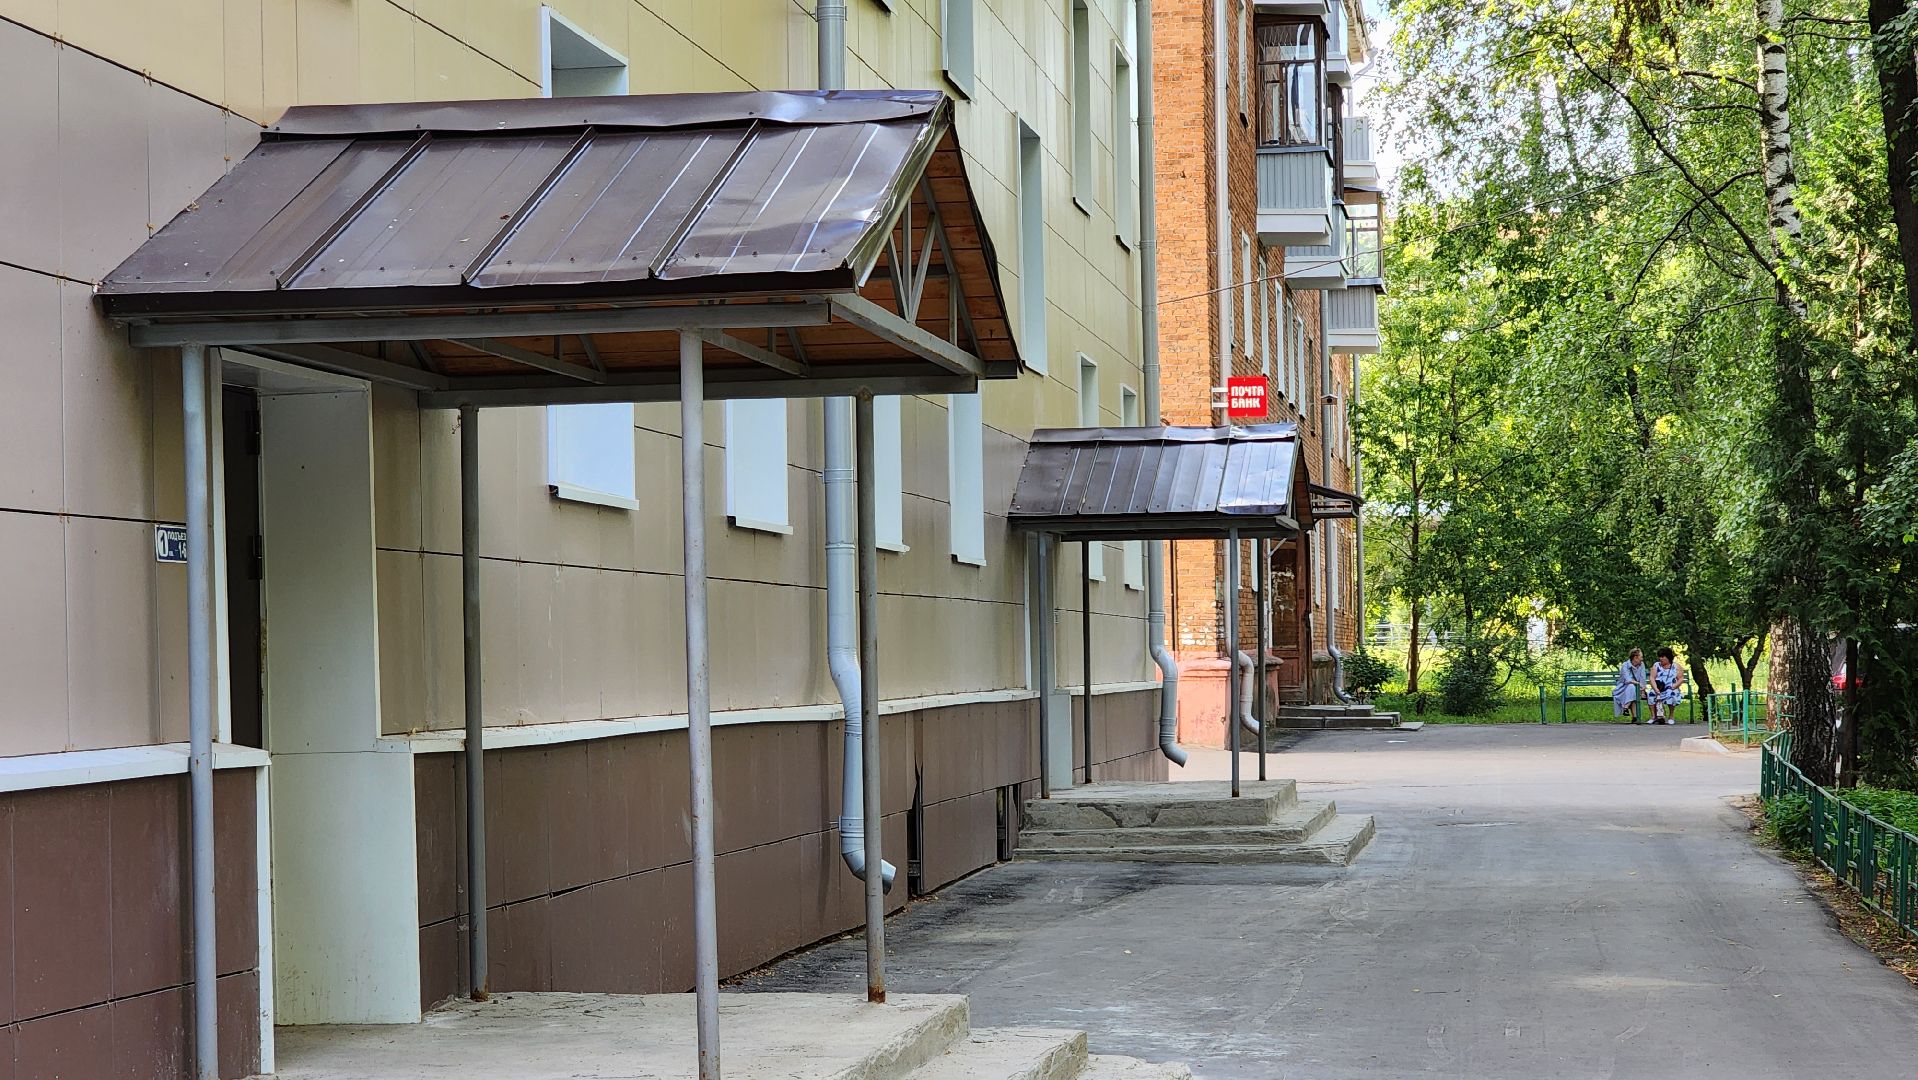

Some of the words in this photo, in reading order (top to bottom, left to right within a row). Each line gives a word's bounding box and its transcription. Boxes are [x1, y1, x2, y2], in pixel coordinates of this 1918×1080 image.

[1231, 386, 1264, 397] ПОЧТА
[1231, 398, 1261, 409] БАНК
[167, 531, 187, 541] ПОДЪЕЗ
